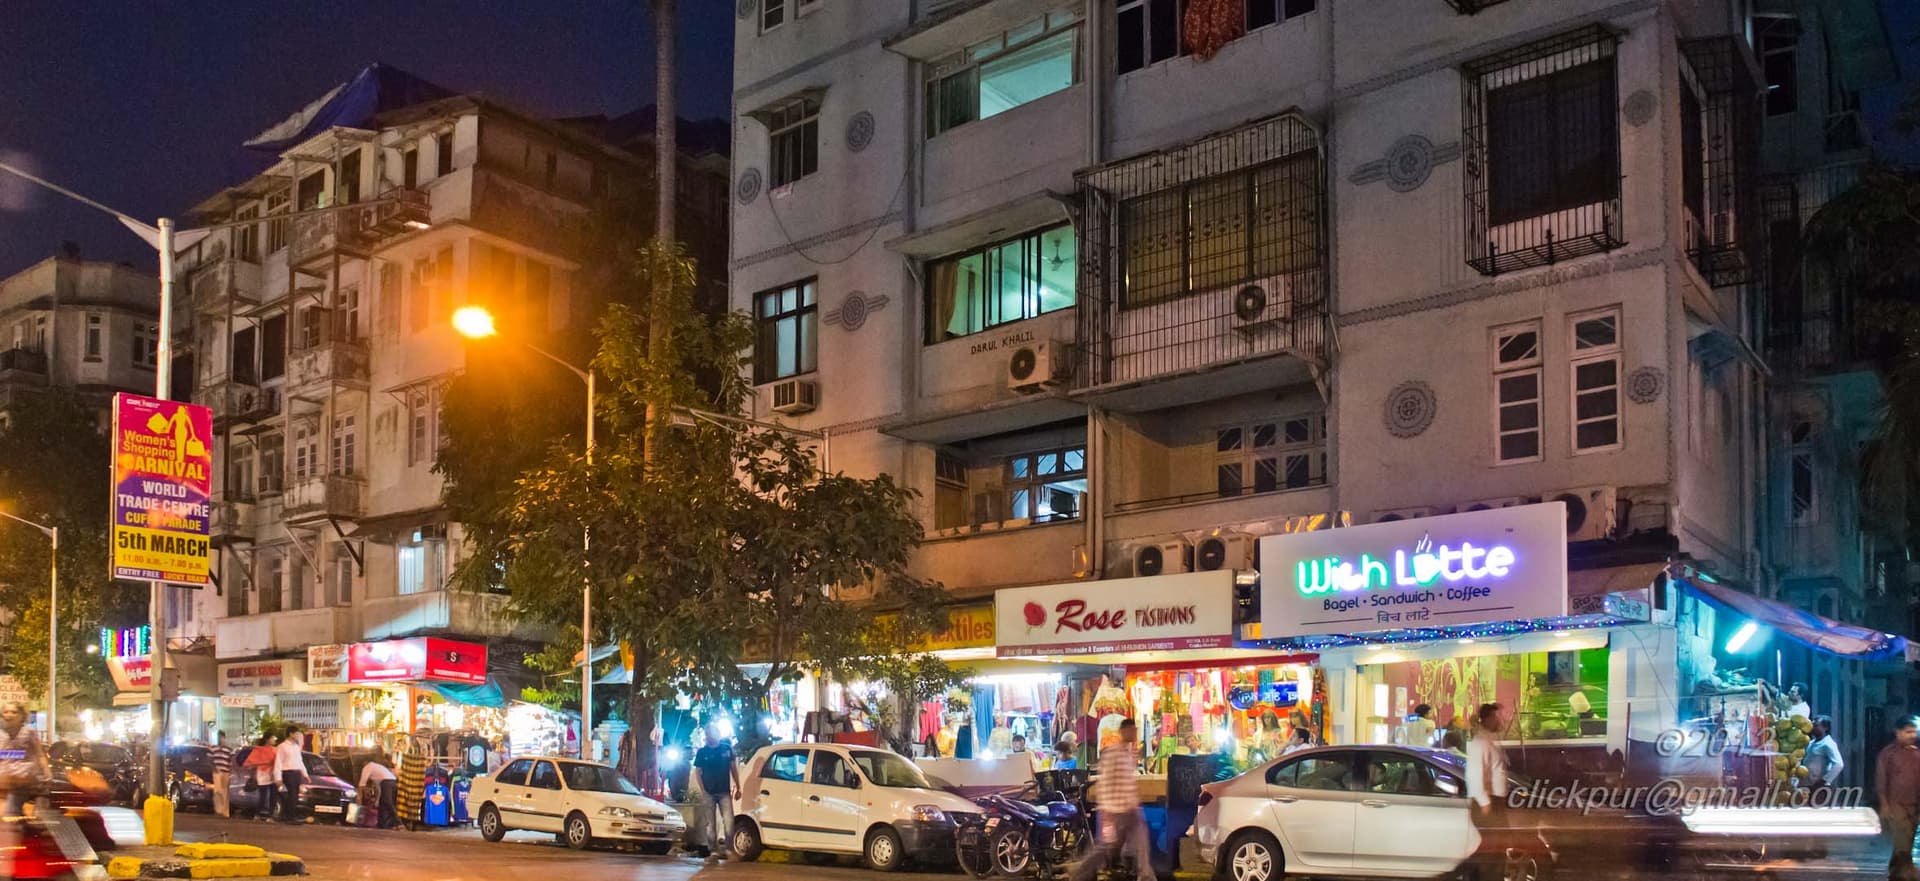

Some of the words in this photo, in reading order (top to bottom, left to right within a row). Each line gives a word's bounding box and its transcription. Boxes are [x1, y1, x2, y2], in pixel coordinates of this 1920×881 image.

[971, 341, 998, 355] DARUL
[1002, 331, 1035, 347] KHALIL
[124, 430, 176, 448] Women's
[123, 441, 176, 460] Shopping
[143, 480, 187, 498] WORLD
[118, 494, 159, 510] TRADE
[163, 500, 209, 517] CENTRE
[126, 512, 160, 527] CUF
[118, 531, 147, 550] 5th
[151, 535, 208, 557] MARCH
[118, 568, 140, 576] ENTRY
[142, 570, 160, 578] FREE
[1323, 597, 1359, 612] Bagel
[1371, 591, 1434, 607] Sandwich
[1447, 586, 1491, 602] Coffee
[1055, 599, 1126, 634] Rose
[1135, 604, 1197, 628] FASHIONS
